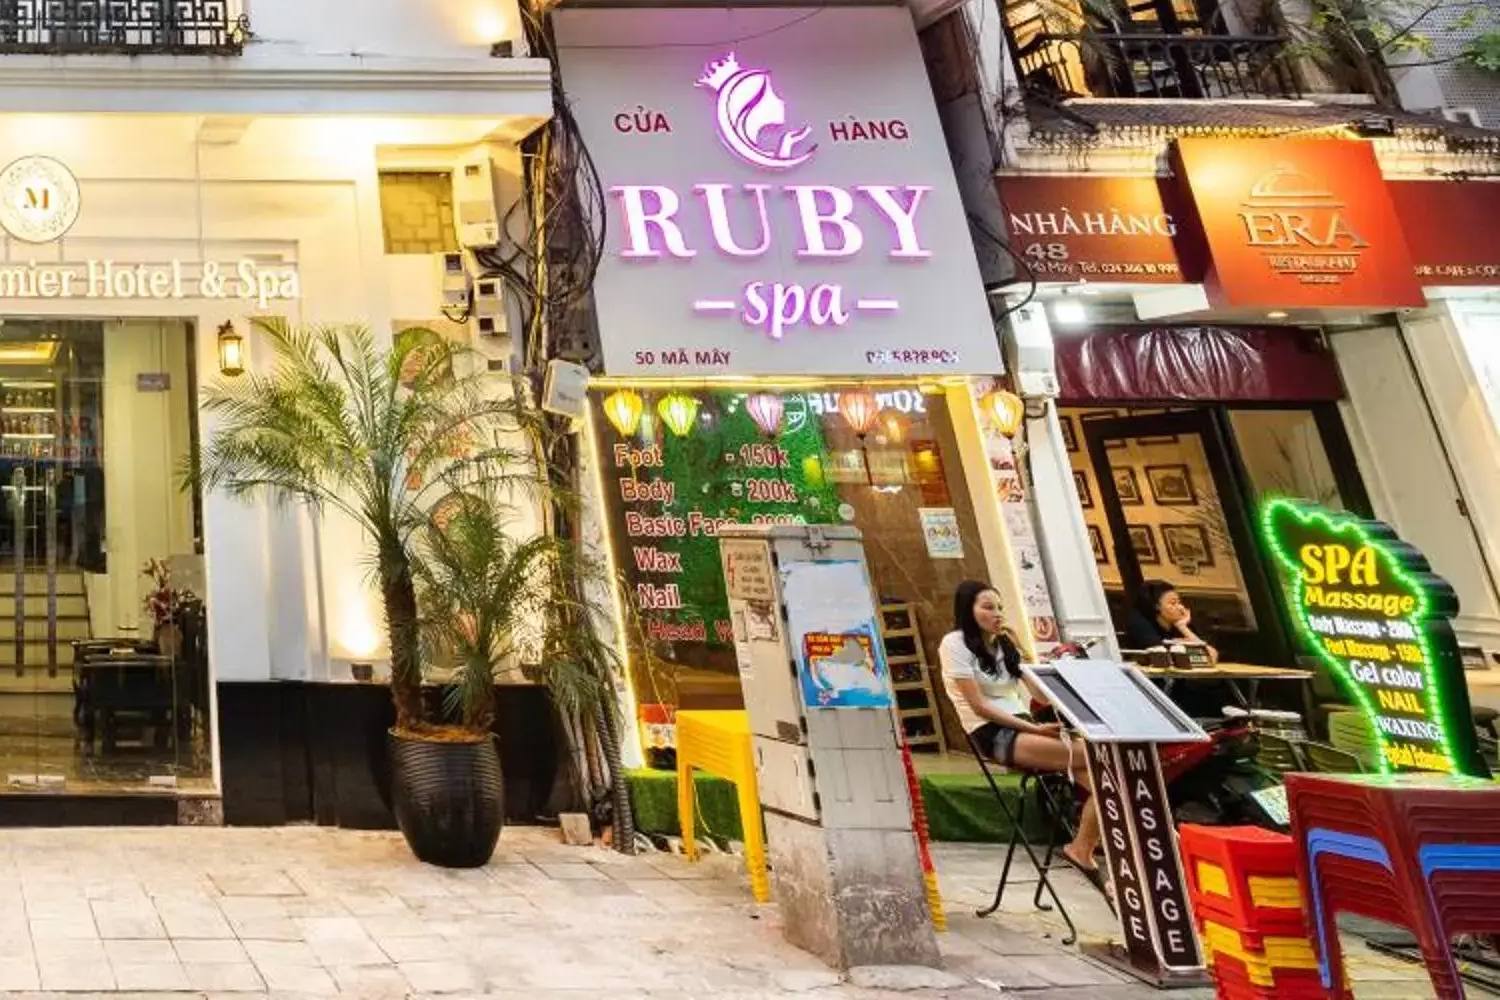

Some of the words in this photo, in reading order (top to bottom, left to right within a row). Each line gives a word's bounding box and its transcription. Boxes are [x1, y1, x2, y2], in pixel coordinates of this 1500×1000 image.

[614, 105, 672, 133] CỬA
[830, 115, 910, 141] HÀNG
[608, 184, 934, 259] RUBY
[1010, 206, 1082, 236] NHÀ
[1082, 208, 1177, 238] HÀNG
[1237, 211, 1371, 249] ERA
[1025, 243, 1069, 261] 48
[85, 257, 184, 298] Hotel
[199, 260, 227, 298] &
[236, 258, 301, 309] Spa
[739, 280, 850, 338] spa
[635, 350, 655, 365] 50
[614, 443, 665, 468] Foot
[620, 477, 677, 506] Body
[746, 478, 799, 503] 200k
[626, 511, 687, 537] Basic
[633, 546, 683, 573] Wax
[1301, 543, 1380, 587] SPA
[637, 583, 682, 609] Nail
[1304, 585, 1416, 617] Massage
[1350, 659, 1381, 684] Gel
[1381, 663, 1424, 689] color
[1376, 689, 1425, 714] NAIL
[1095, 743, 1146, 941] MASSAGE
[1127, 748, 1186, 954] MASSAGE
